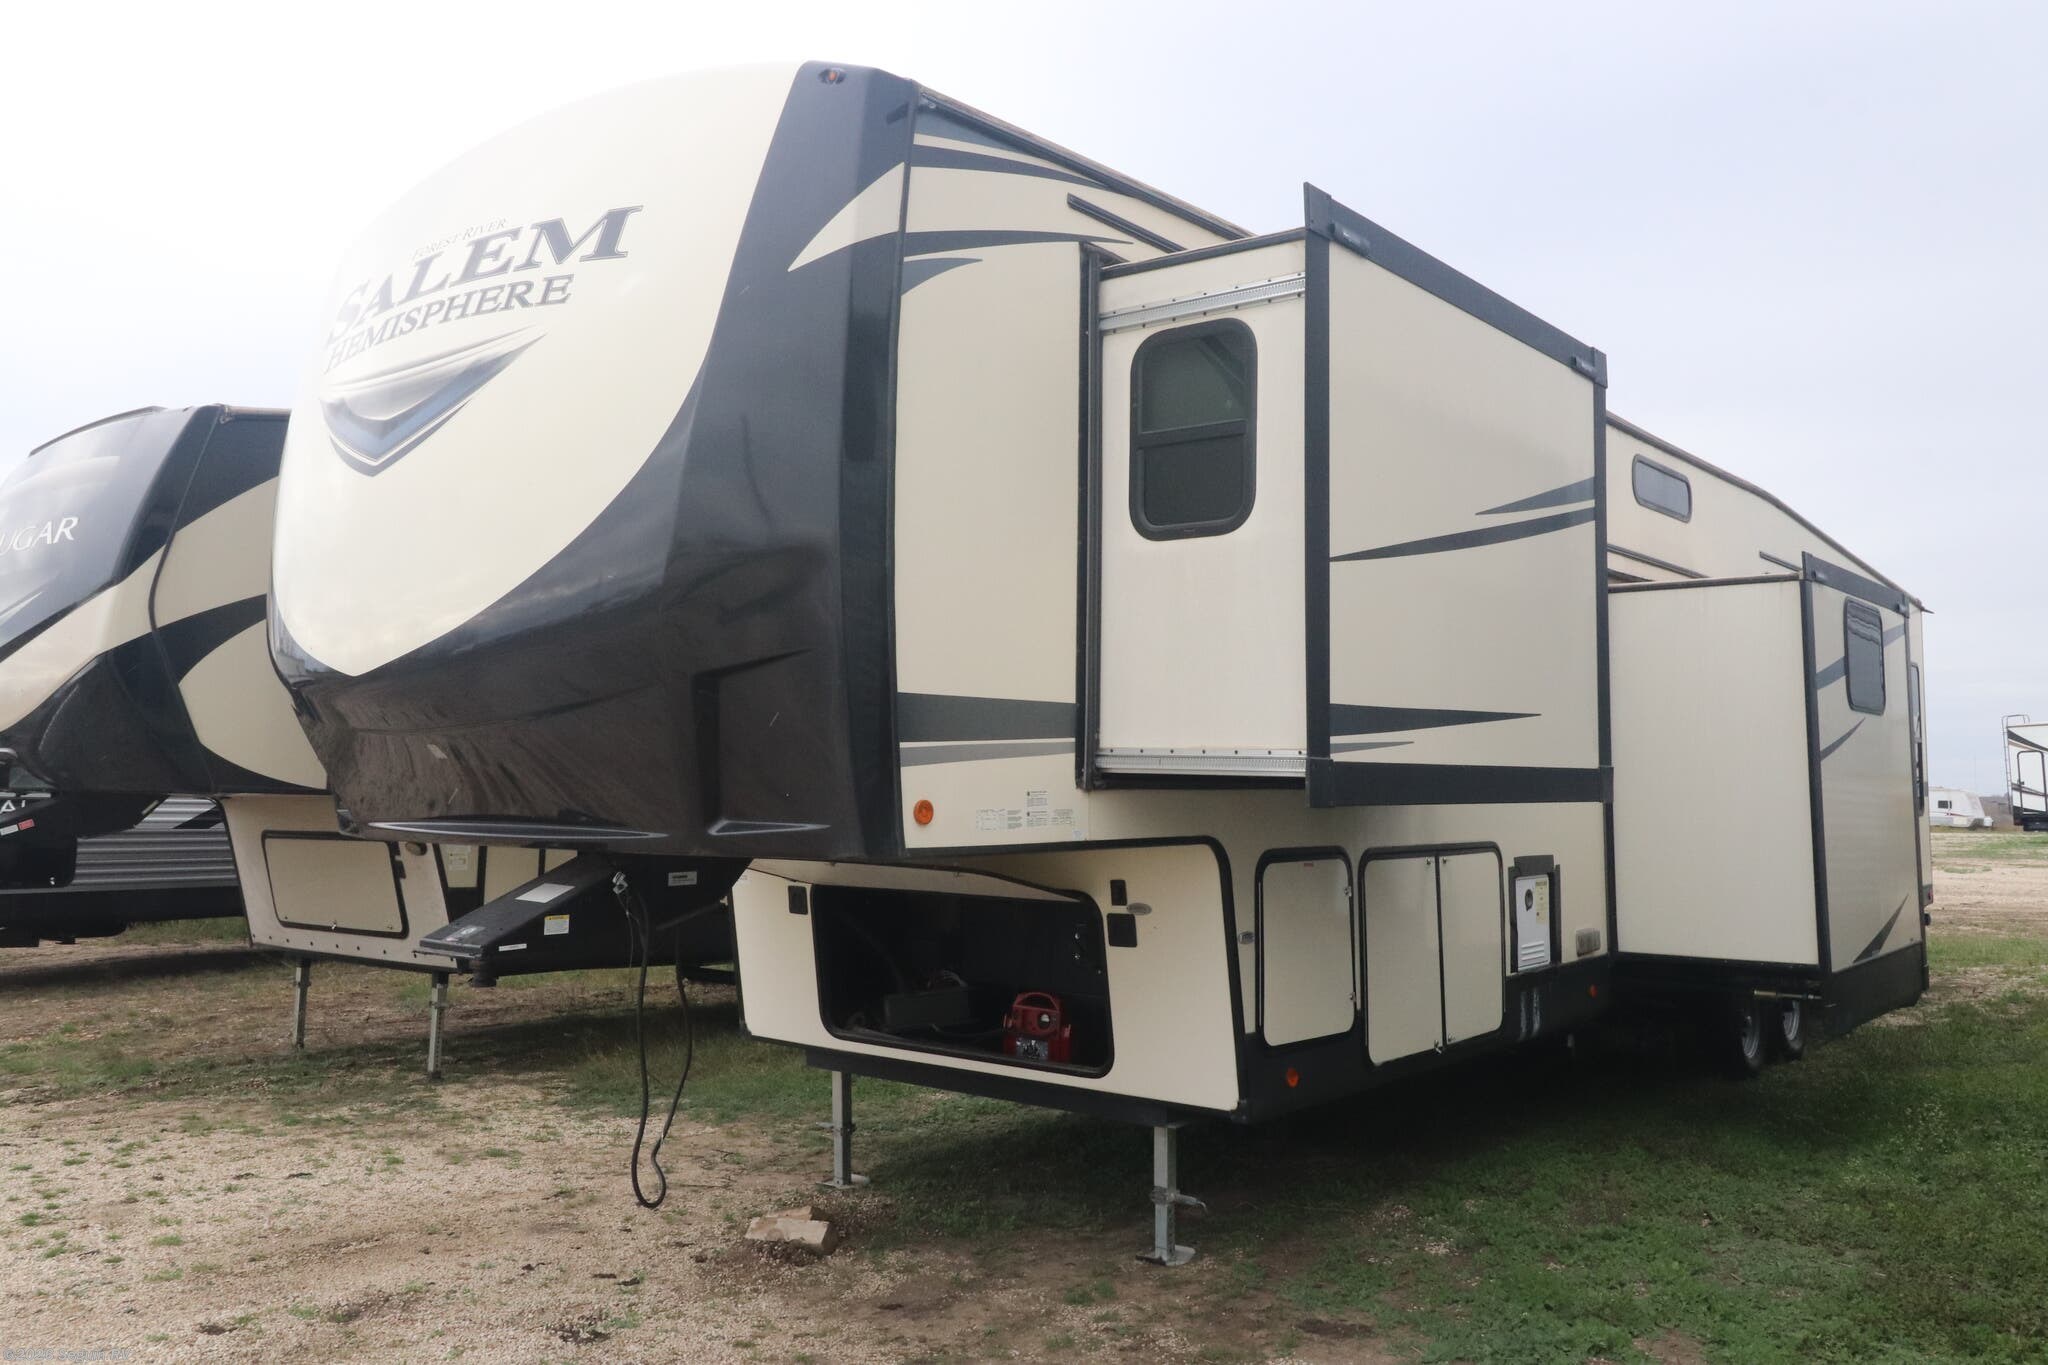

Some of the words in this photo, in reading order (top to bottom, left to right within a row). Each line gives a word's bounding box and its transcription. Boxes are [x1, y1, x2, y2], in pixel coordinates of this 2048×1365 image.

[325, 205, 644, 348] SALEM
[463, 217, 508, 241] RIVER
[323, 273, 575, 374] HEMISPHERE
